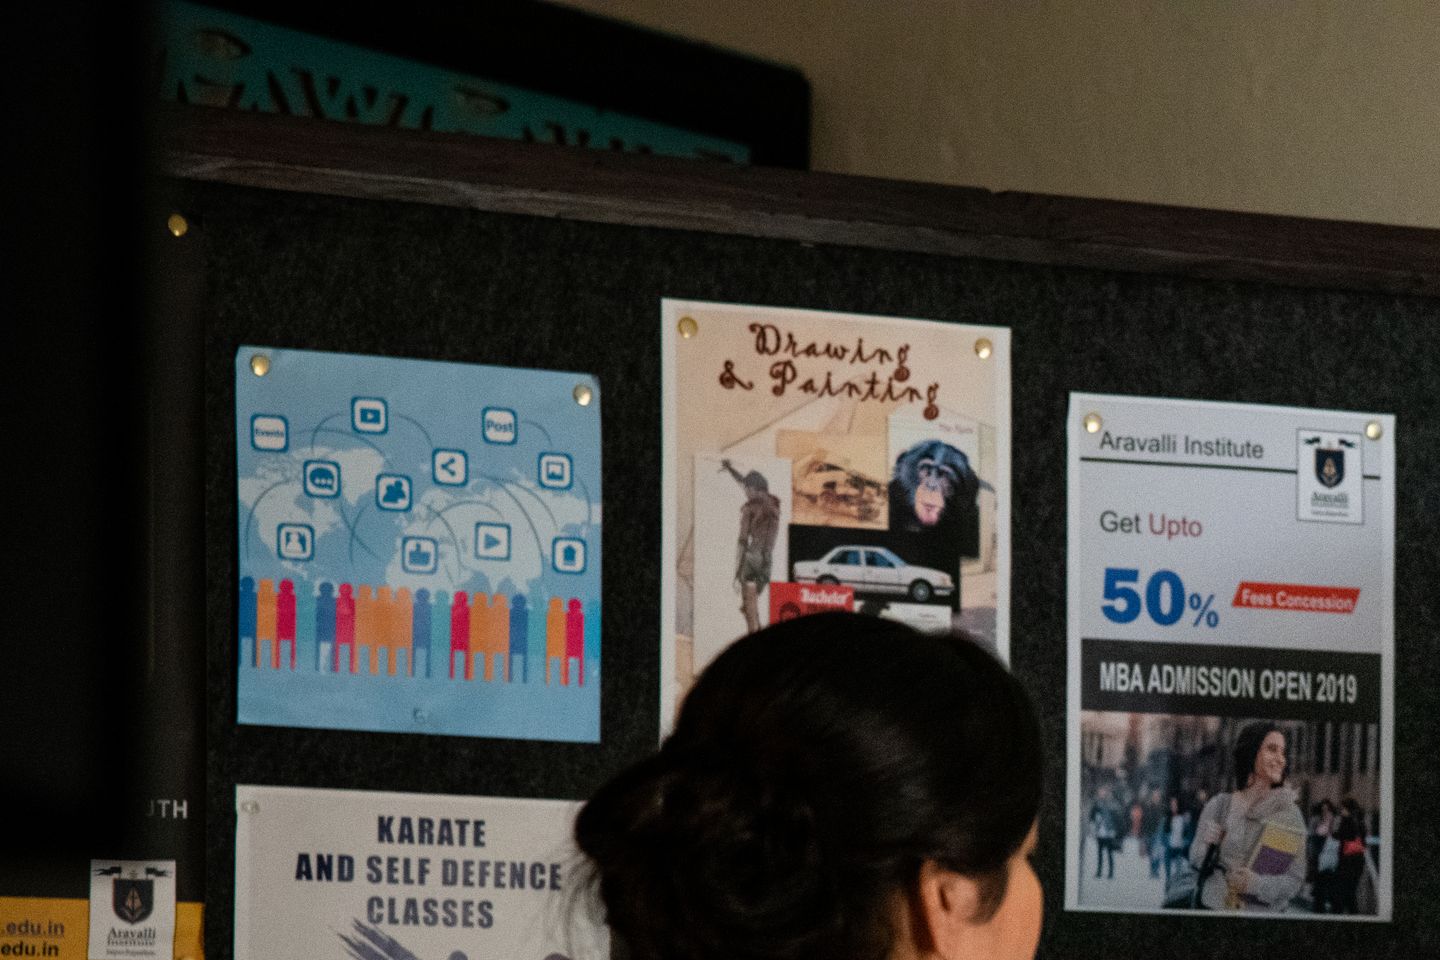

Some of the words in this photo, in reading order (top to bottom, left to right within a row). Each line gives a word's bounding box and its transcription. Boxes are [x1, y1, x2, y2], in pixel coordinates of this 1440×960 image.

[749, 323, 910, 382] Drawing
[719, 359, 753, 390] &
[770, 360, 939, 420] Painting
[486, 418, 514, 433] Post
[1100, 432, 1177, 453] Aravalli
[1184, 436, 1264, 459] Institute
[1100, 510, 1142, 533] Get
[1149, 513, 1203, 539] Upto
[1101, 567, 1219, 628] 50%
[1241, 589, 1273, 606] Fees
[1276, 591, 1353, 610] Concession
[1100, 662, 1144, 693] MBA
[1147, 664, 1255, 698] ADMISSION
[1259, 669, 1312, 700] OPEN
[1315, 673, 1358, 703] 2019
[377, 815, 487, 847] KARATE
[295, 853, 355, 883] AND
[366, 855, 430, 885] SELF
[442, 859, 562, 891] DEFENCE
[366, 896, 494, 929] CLASSES
[108, 927, 157, 939] Aravalli
